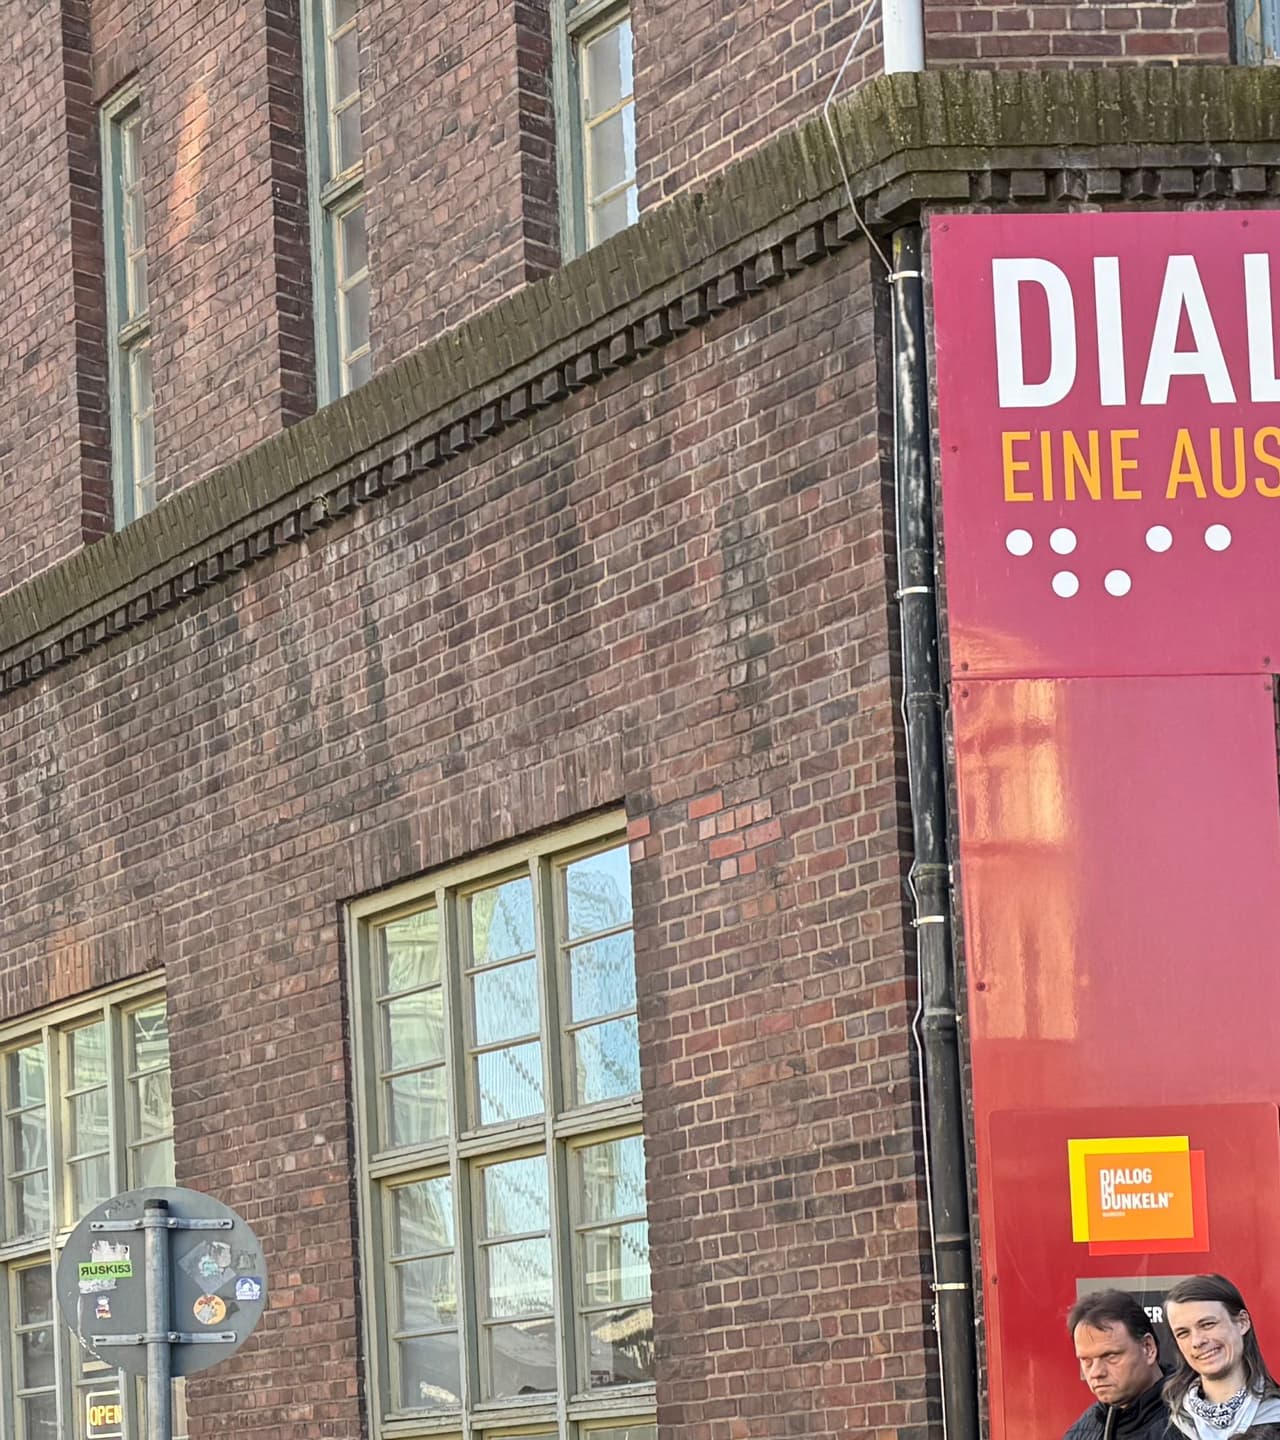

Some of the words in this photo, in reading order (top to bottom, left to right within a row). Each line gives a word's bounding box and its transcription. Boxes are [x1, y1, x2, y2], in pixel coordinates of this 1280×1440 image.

[1001, 429, 1143, 502] EINE
[1100, 1167, 1152, 1185] DIALOG
[1101, 1191, 1174, 1210] DUNKELN
[90, 1404, 123, 1426] OPEN
